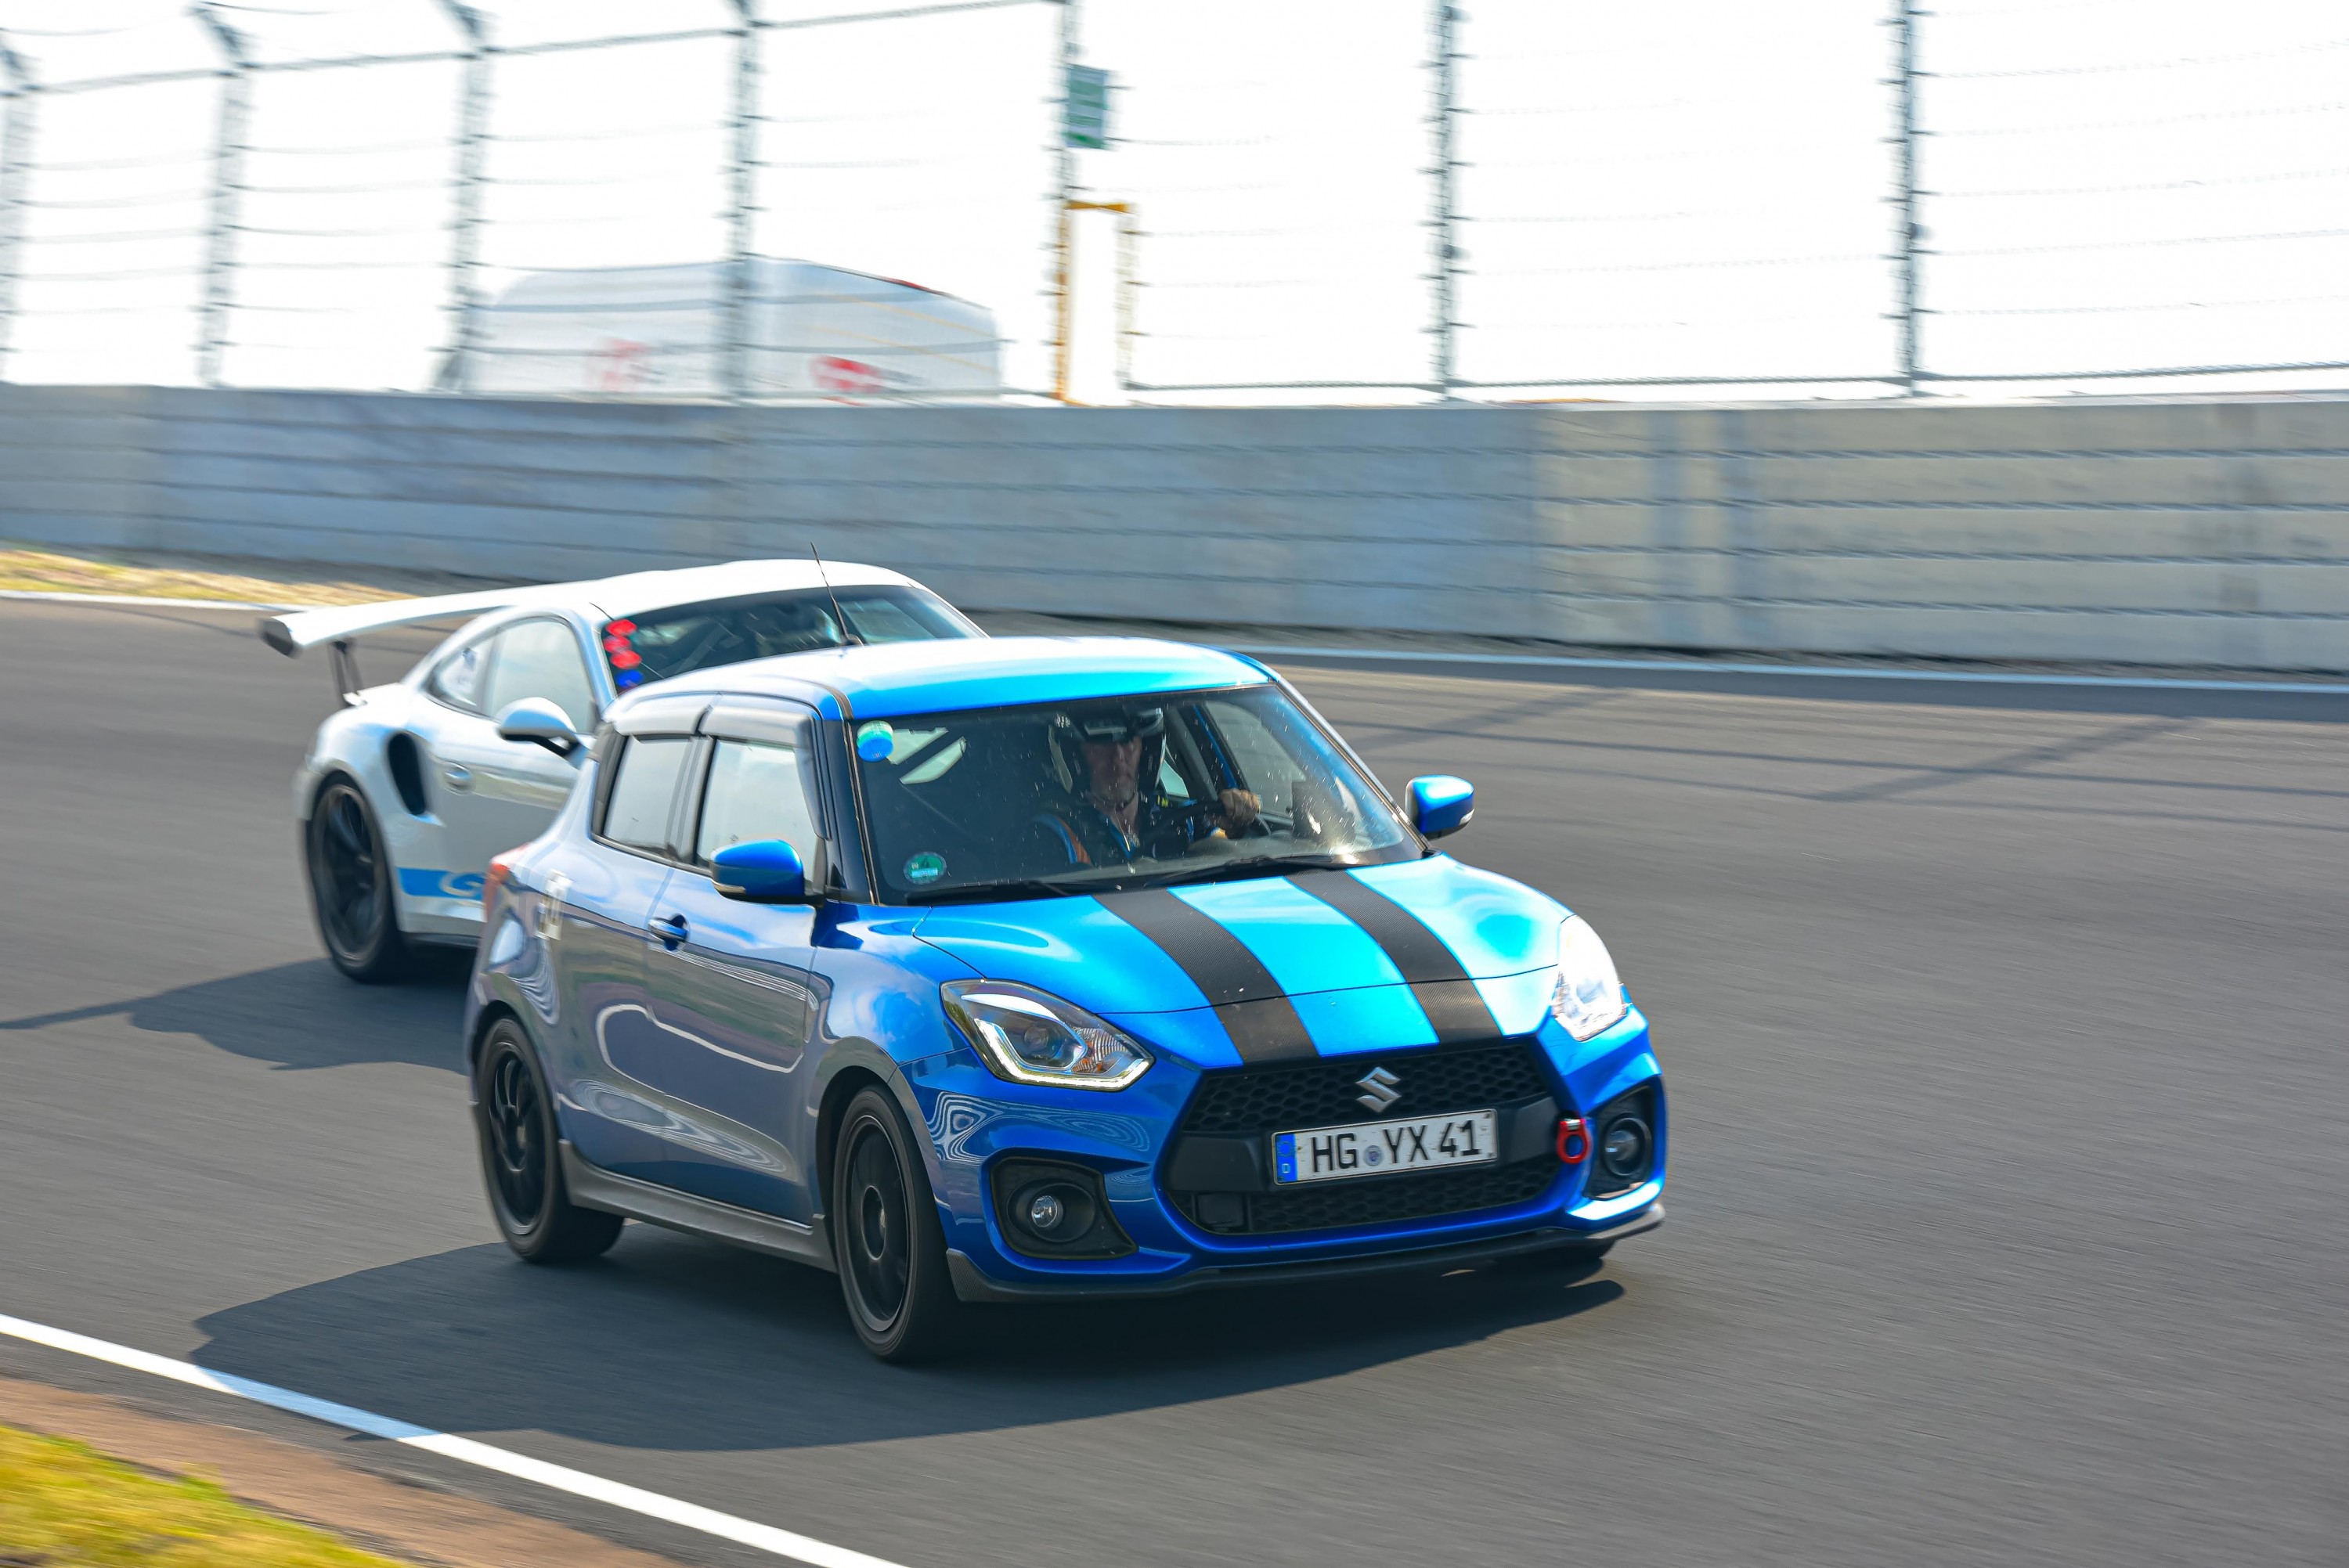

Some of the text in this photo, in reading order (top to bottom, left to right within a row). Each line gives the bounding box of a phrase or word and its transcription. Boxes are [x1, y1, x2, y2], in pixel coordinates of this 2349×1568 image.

[1312, 1119, 1480, 1173] HG YX 41
